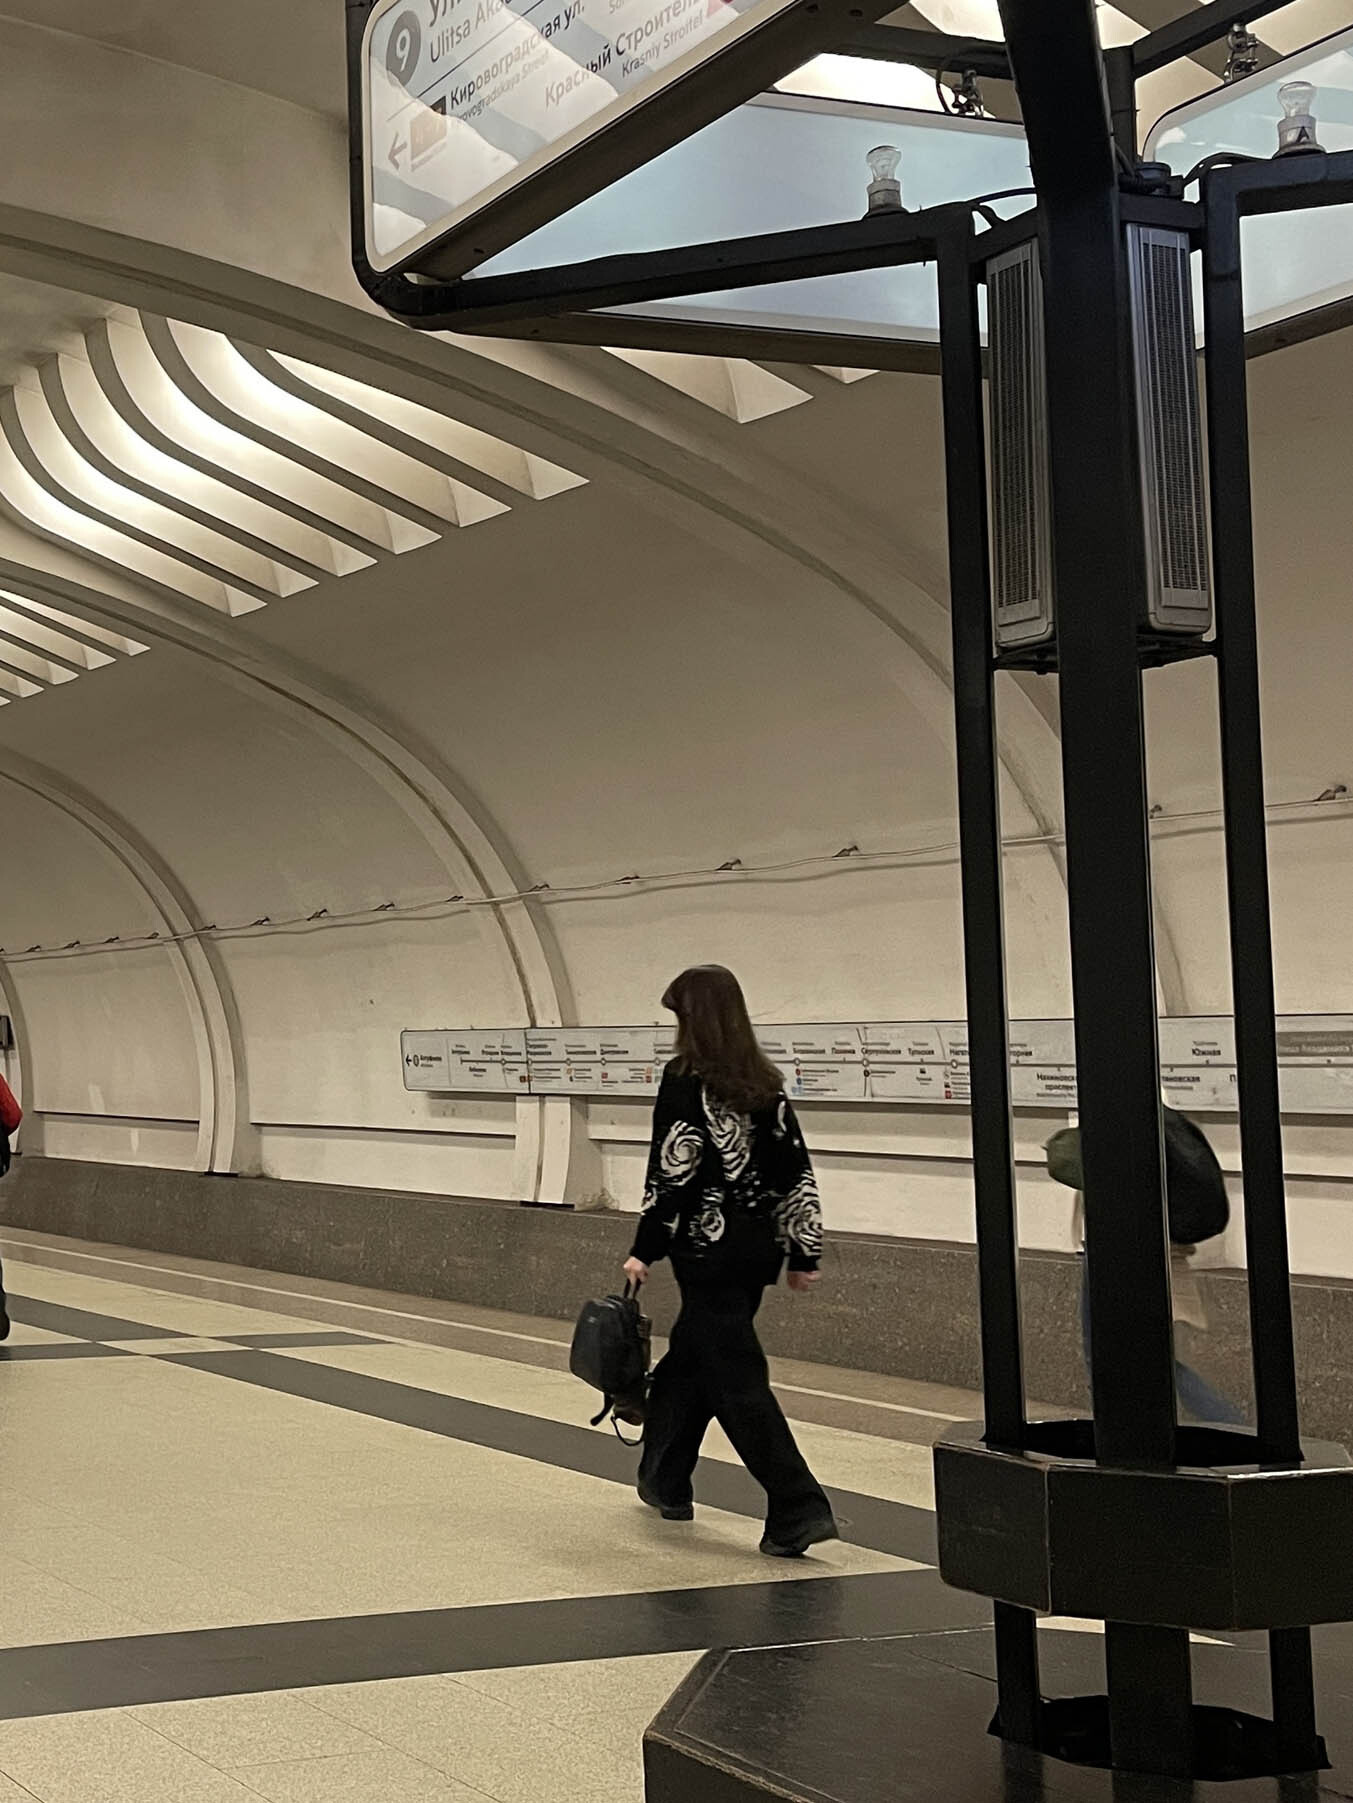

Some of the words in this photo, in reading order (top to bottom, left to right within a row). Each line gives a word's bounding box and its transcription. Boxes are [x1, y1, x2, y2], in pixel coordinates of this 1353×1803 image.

[563, 2, 585, 29] ул.
[429, 24, 470, 63] Ulitsa
[545, 45, 611, 108] Красный
